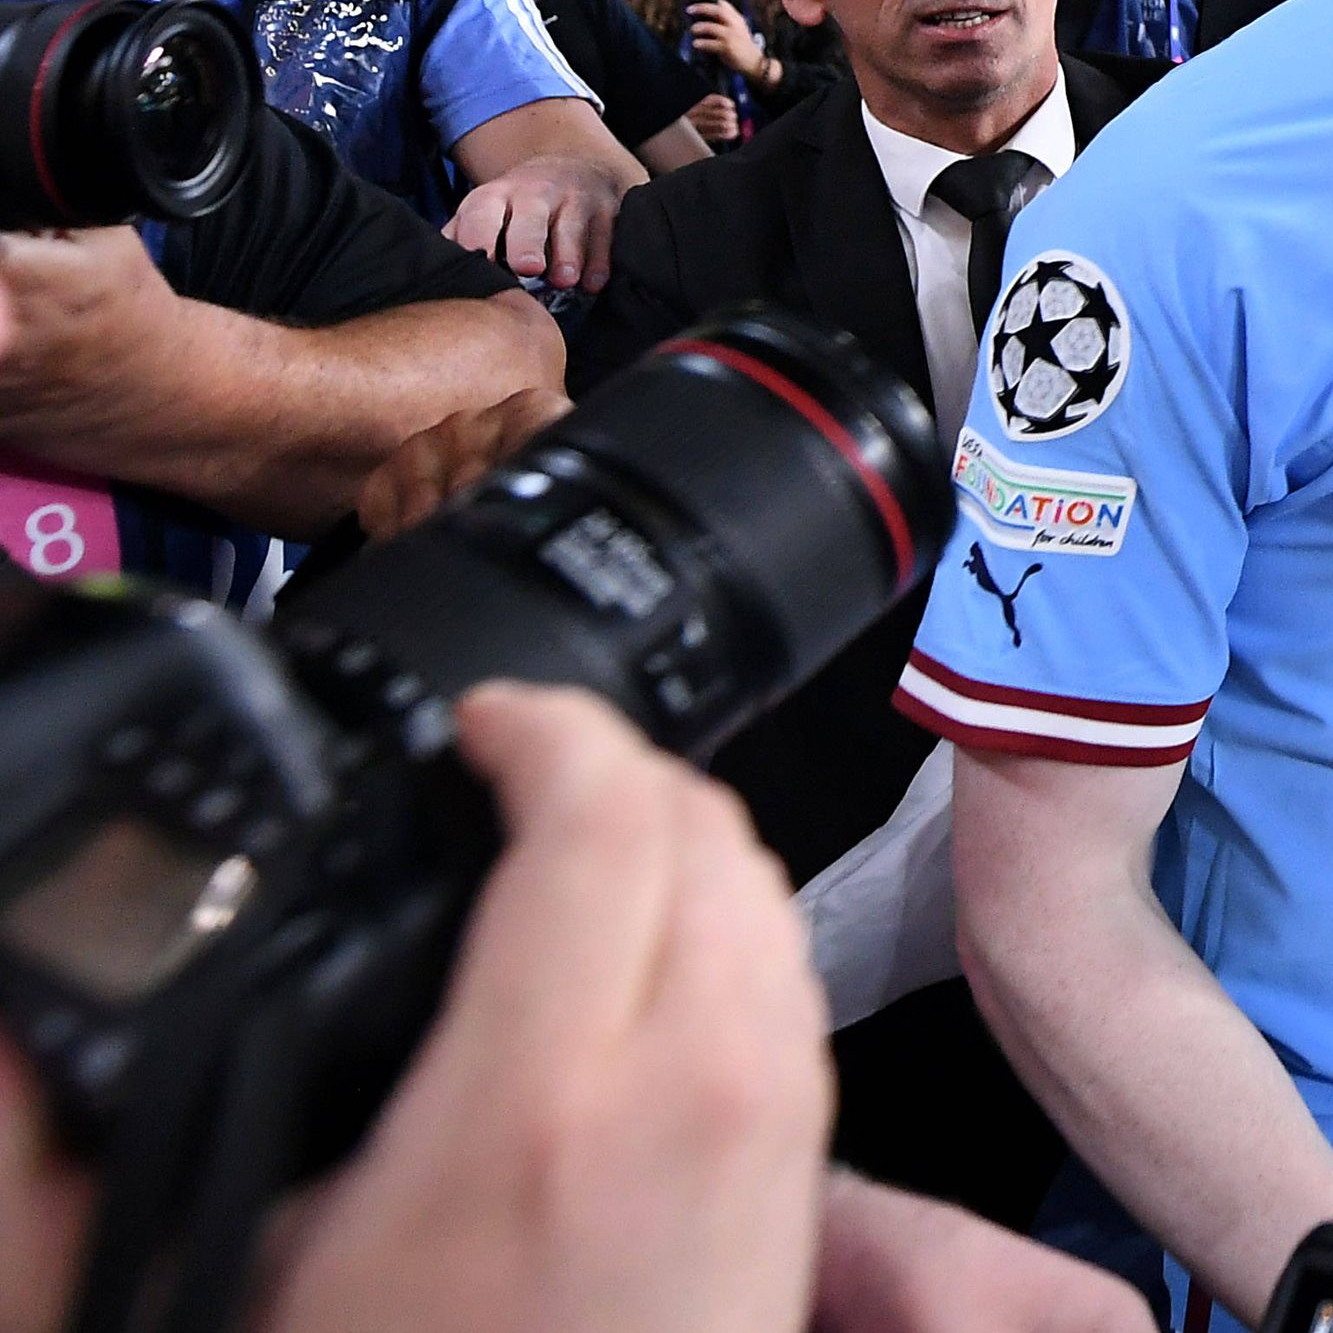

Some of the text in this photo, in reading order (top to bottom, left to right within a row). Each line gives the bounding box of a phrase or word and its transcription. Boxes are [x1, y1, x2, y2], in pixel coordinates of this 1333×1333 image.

[24, 503, 86, 576] 8
[1031, 528, 1114, 549] for children
